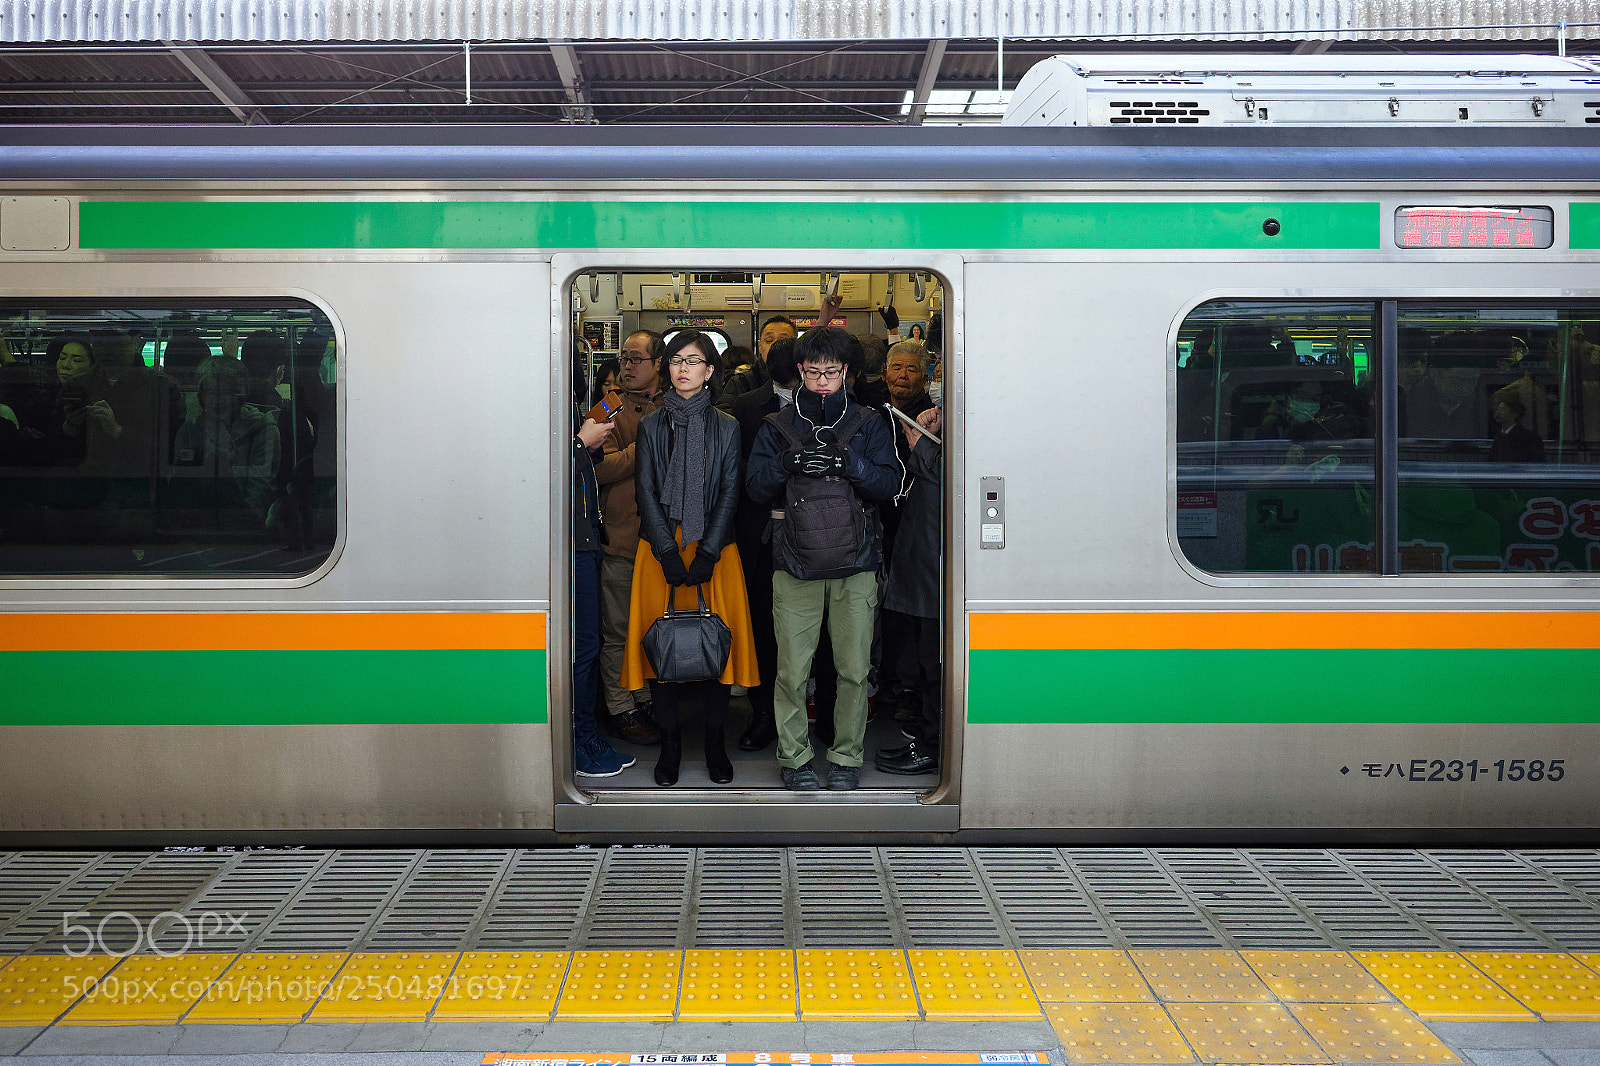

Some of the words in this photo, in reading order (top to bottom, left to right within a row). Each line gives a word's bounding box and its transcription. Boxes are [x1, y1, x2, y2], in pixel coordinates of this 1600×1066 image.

[1403, 228, 1535, 247] 横須賀線直通
